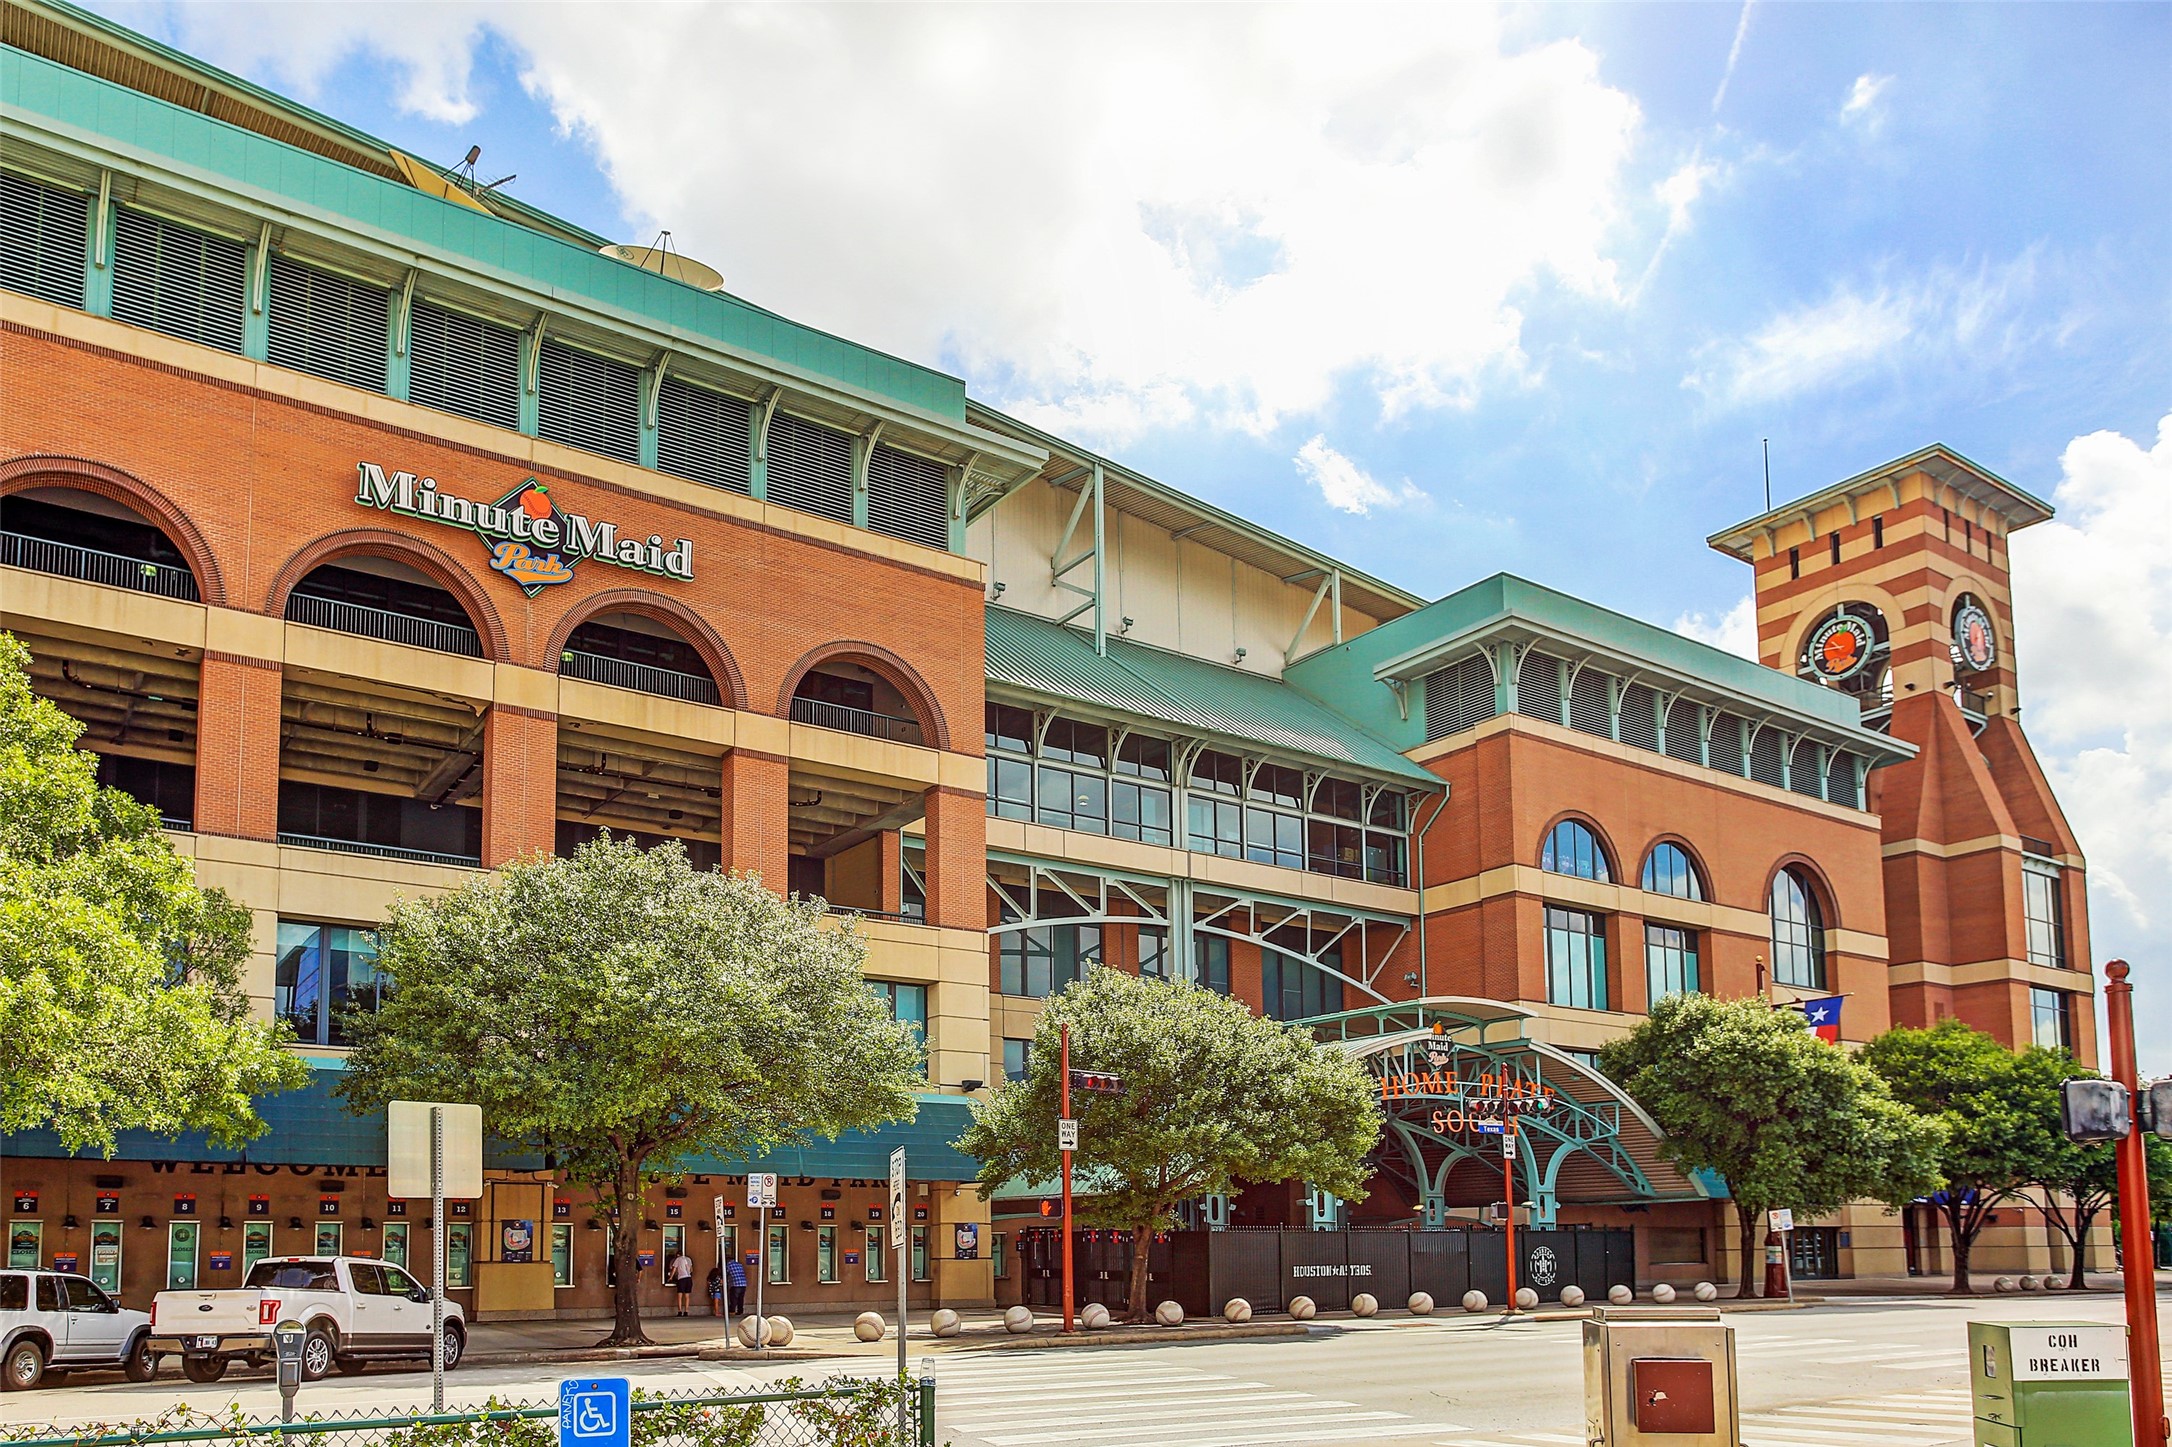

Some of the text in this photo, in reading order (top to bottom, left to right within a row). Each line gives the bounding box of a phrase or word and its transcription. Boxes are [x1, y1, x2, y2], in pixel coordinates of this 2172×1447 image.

[355, 461, 696, 582] Minute Maid
[489, 541, 574, 586] Park
[1814, 621, 1866, 661] Minute Maid
[1428, 1041, 1449, 1051] Maid
[1381, 1071, 1459, 1100] HOME
[1061, 1122, 1076, 1130] ONE
[1432, 1110, 1519, 1137] SOUH
[1061, 1130, 1076, 1138] WAY
[1483, 1125, 1499, 1133] Texas
[22, 1202, 30, 1210] 6
[104, 1202, 111, 1210] 7
[182, 1203, 188, 1211] 8
[256, 1203, 262, 1211] 9
[456, 1205, 466, 1213] 12
[1293, 1265, 1332, 1277] HOUSTON
[2047, 1334, 2078, 1348] COH
[2029, 1358, 2101, 1372] BREAKER
